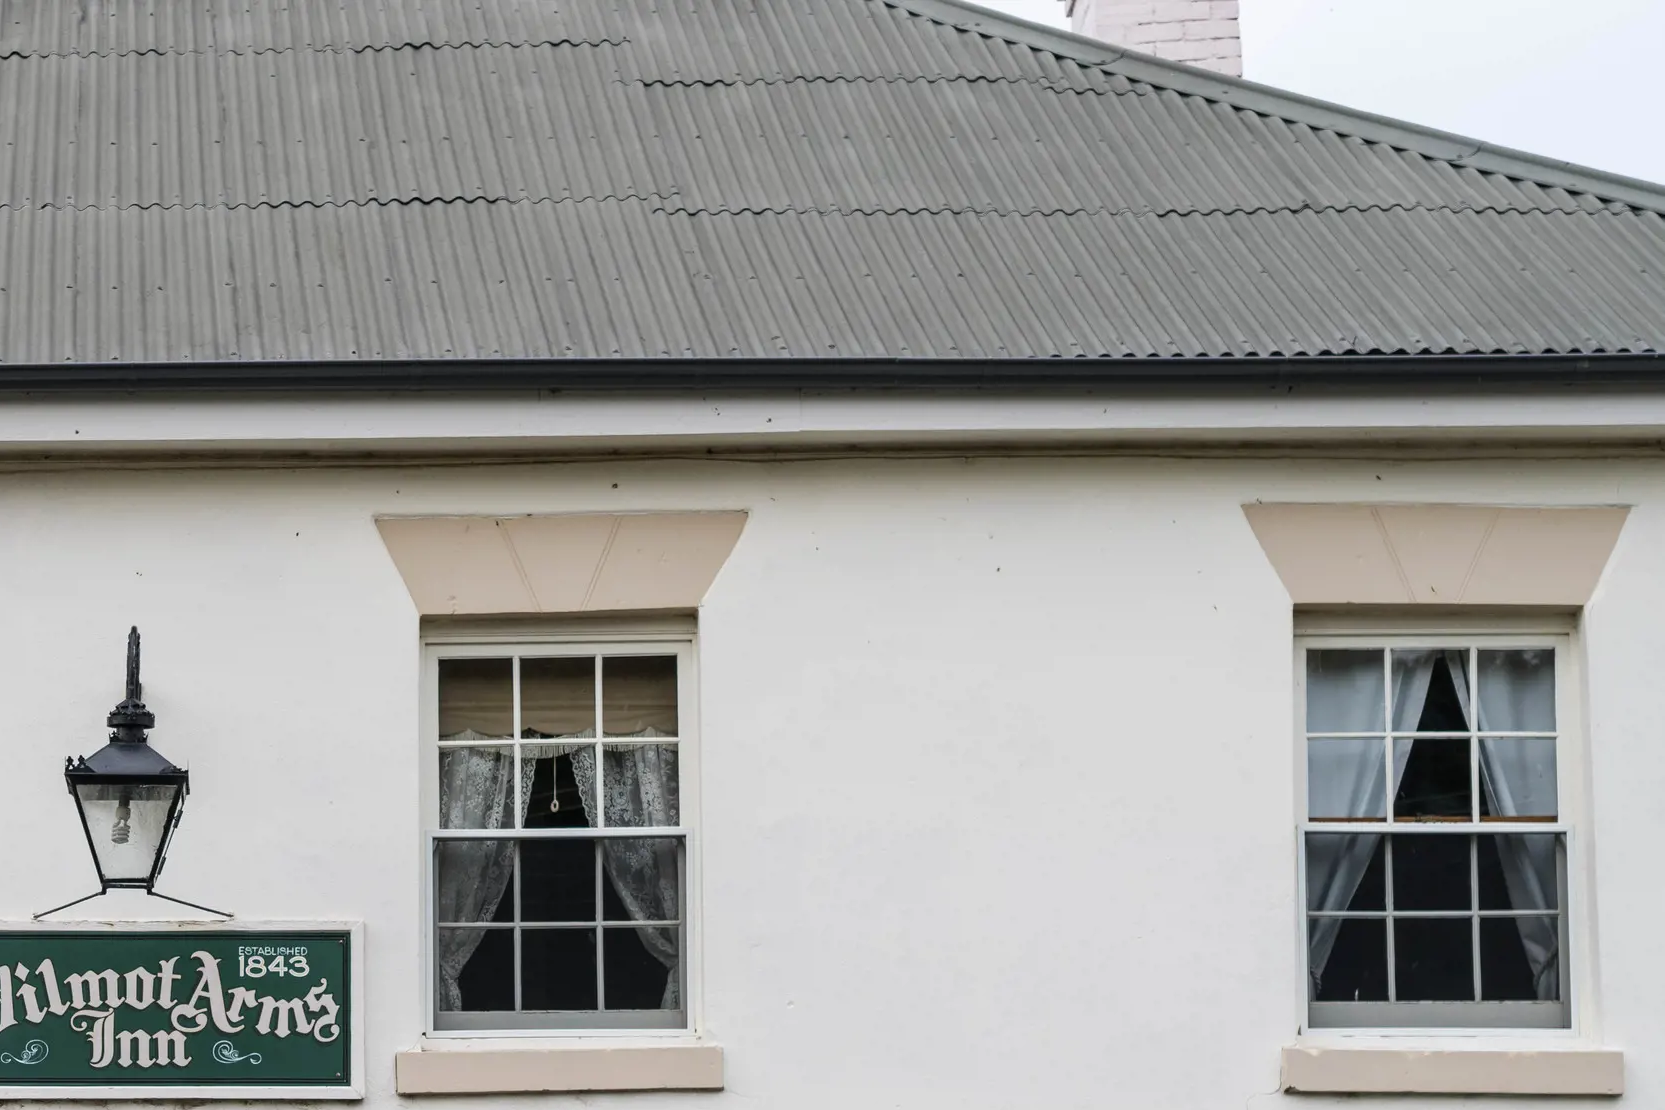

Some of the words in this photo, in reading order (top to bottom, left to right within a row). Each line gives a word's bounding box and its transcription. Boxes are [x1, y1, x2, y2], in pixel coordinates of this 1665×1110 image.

[238, 946, 308, 956] ESTABLISHED
[238, 955, 310, 978] 1843
[170, 950, 340, 1042] Arms
[70, 1007, 192, 1068] Inn
